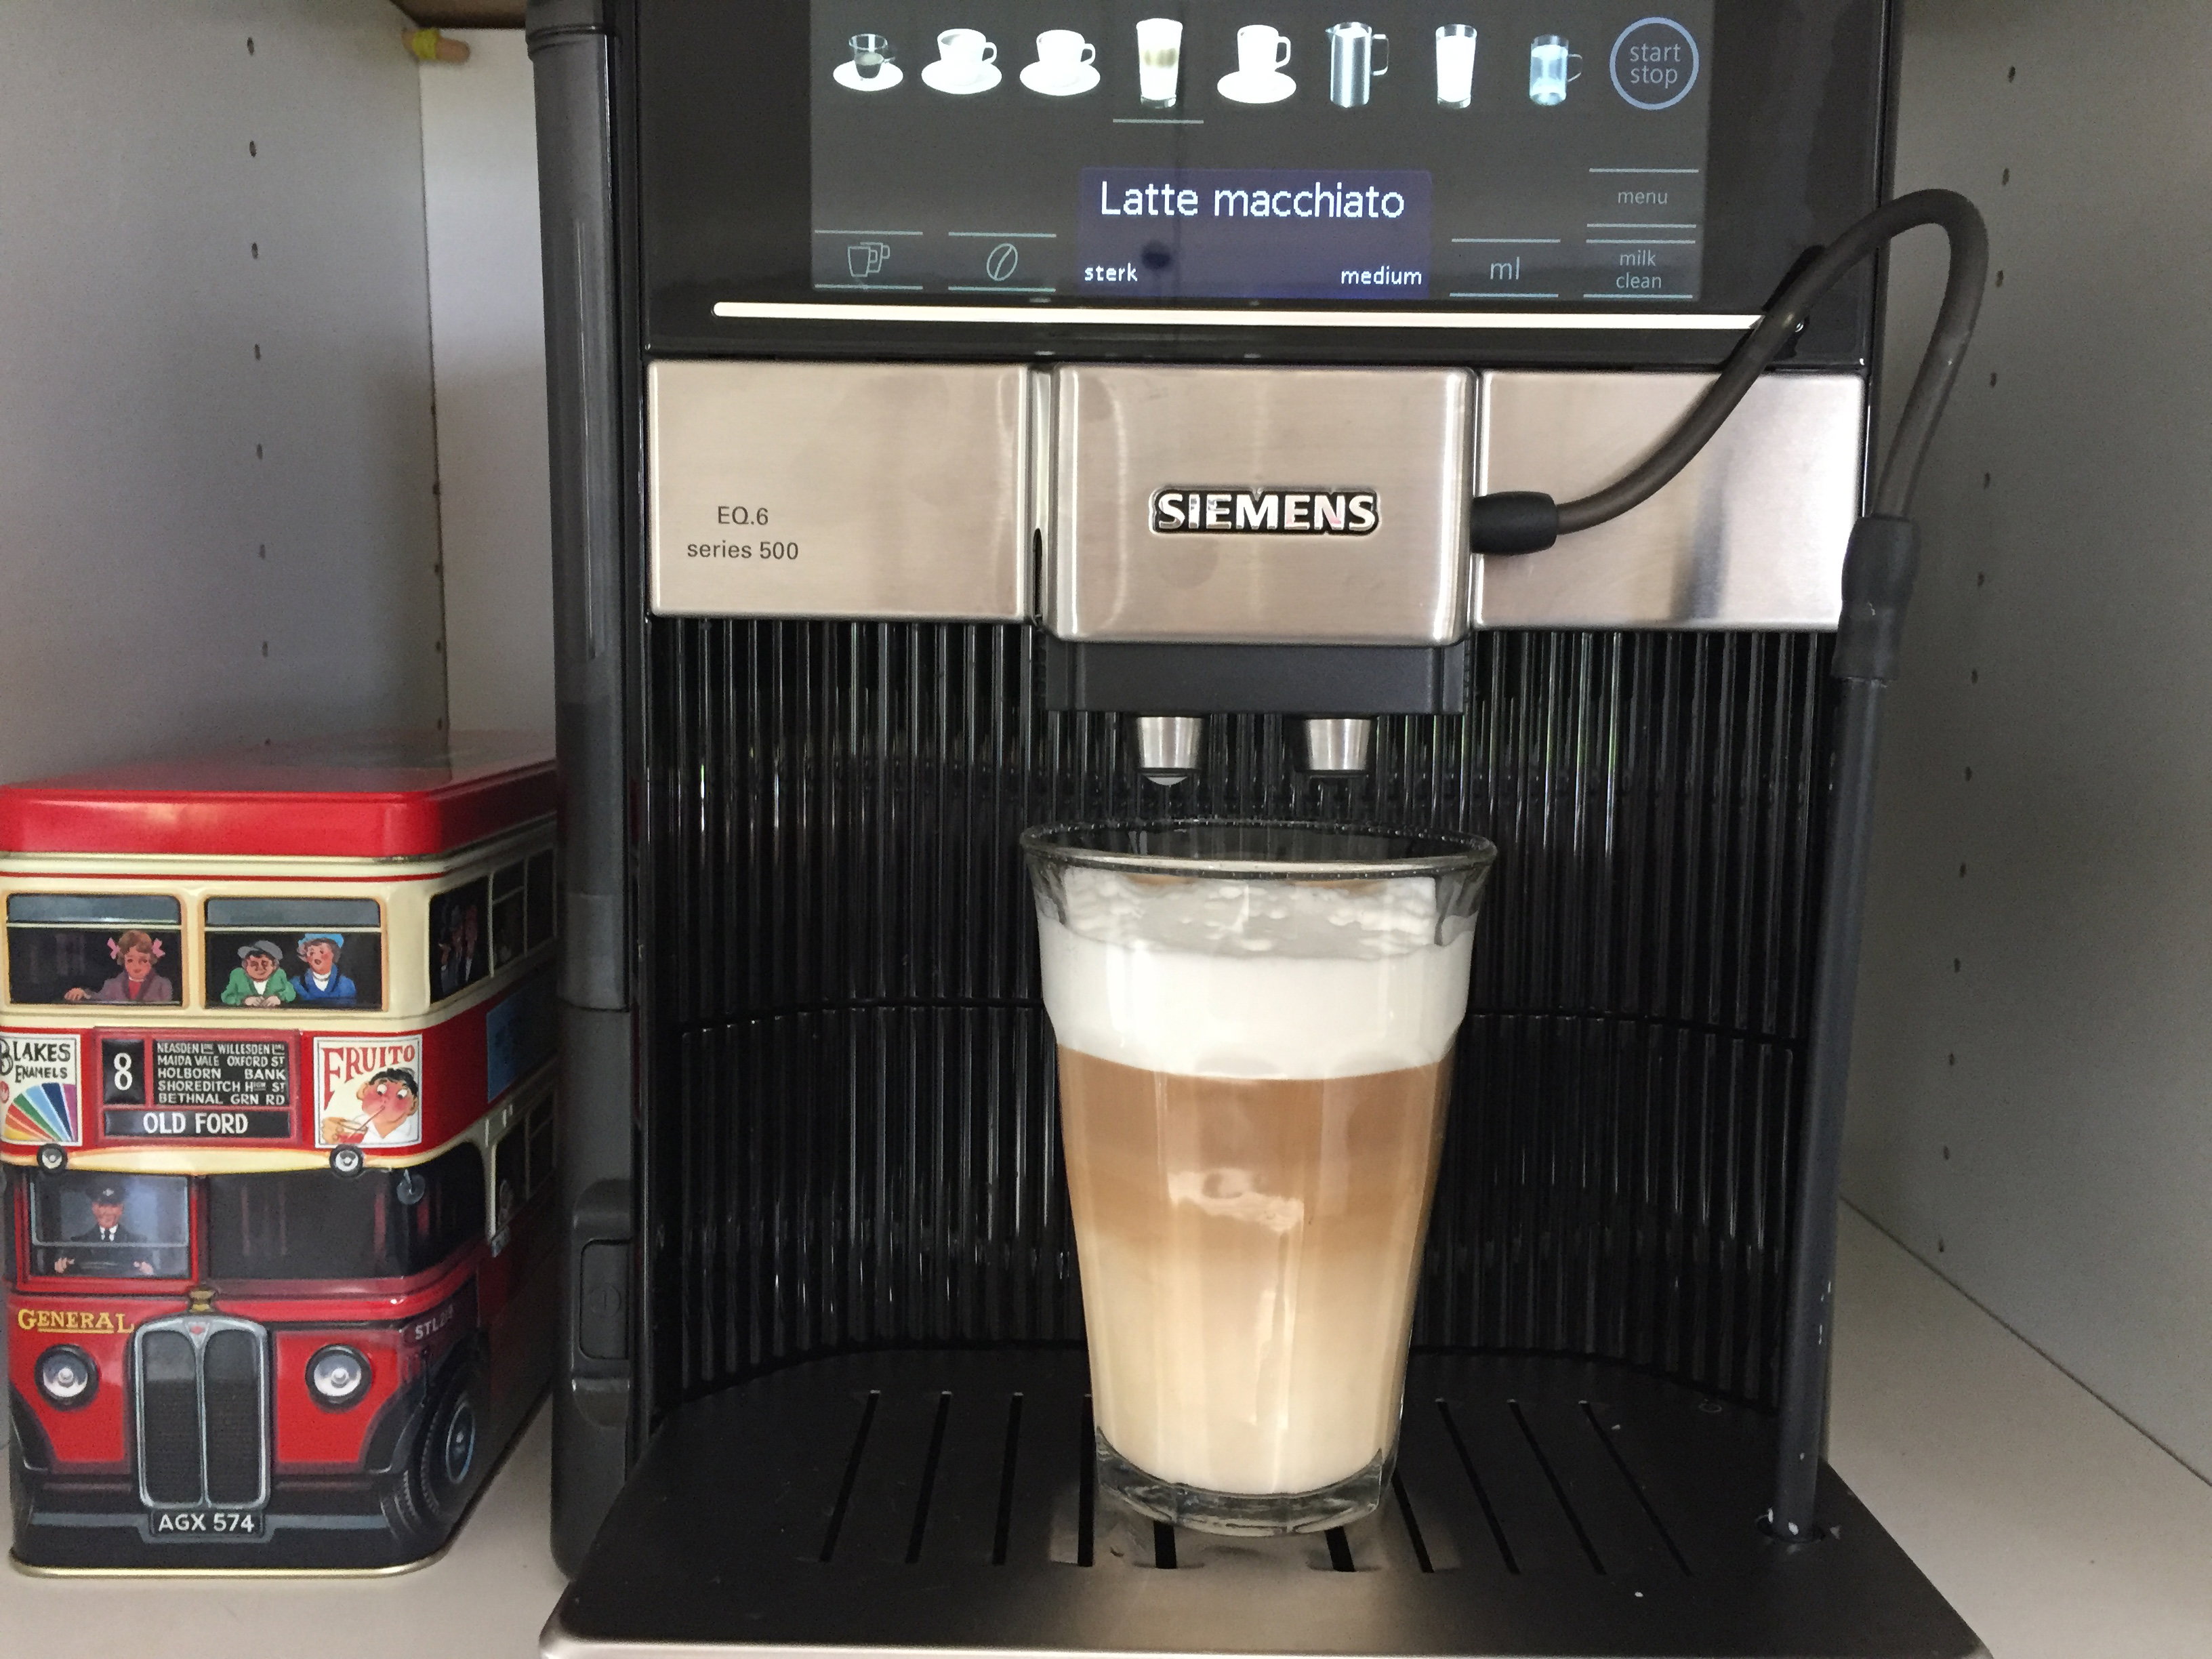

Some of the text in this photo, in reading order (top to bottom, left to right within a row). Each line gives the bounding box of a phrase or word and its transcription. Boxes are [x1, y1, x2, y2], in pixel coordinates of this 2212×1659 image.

[1630, 43, 1681, 62] start
[1630, 65, 1678, 89] stop
[1101, 181, 1405, 218] Latte macchiato
[1618, 190, 1668, 205] menu
[1619, 249, 1656, 266] milk
[1084, 262, 1139, 282] sterk
[1340, 266, 1422, 286] medium
[1490, 256, 1520, 280] ml
[1616, 272, 1662, 289] clean
[718, 506, 769, 526] EQ.6
[1158, 493, 1377, 531] SIEMENS
[687, 540, 799, 560] series 500
[217, 1043, 270, 1054] WILLESDEN
[157, 1054, 192, 1066] MAIDA
[194, 1055, 220, 1067] VALE
[226, 1055, 268, 1067] OXFORD
[15, 1065, 68, 1083] ENAMELS
[113, 1052, 133, 1091] 8
[157, 1067, 286, 1081] HOLBORN BANK
[321, 1044, 415, 1111] FRUITO
[158, 1080, 241, 1092] SHOREDITCH
[159, 1092, 285, 1105] BETHNAL GRN RD
[143, 1111, 249, 1134] OLD FORD
[18, 1308, 135, 1334] GENERAL
[158, 1512, 255, 1533] AGX 574
